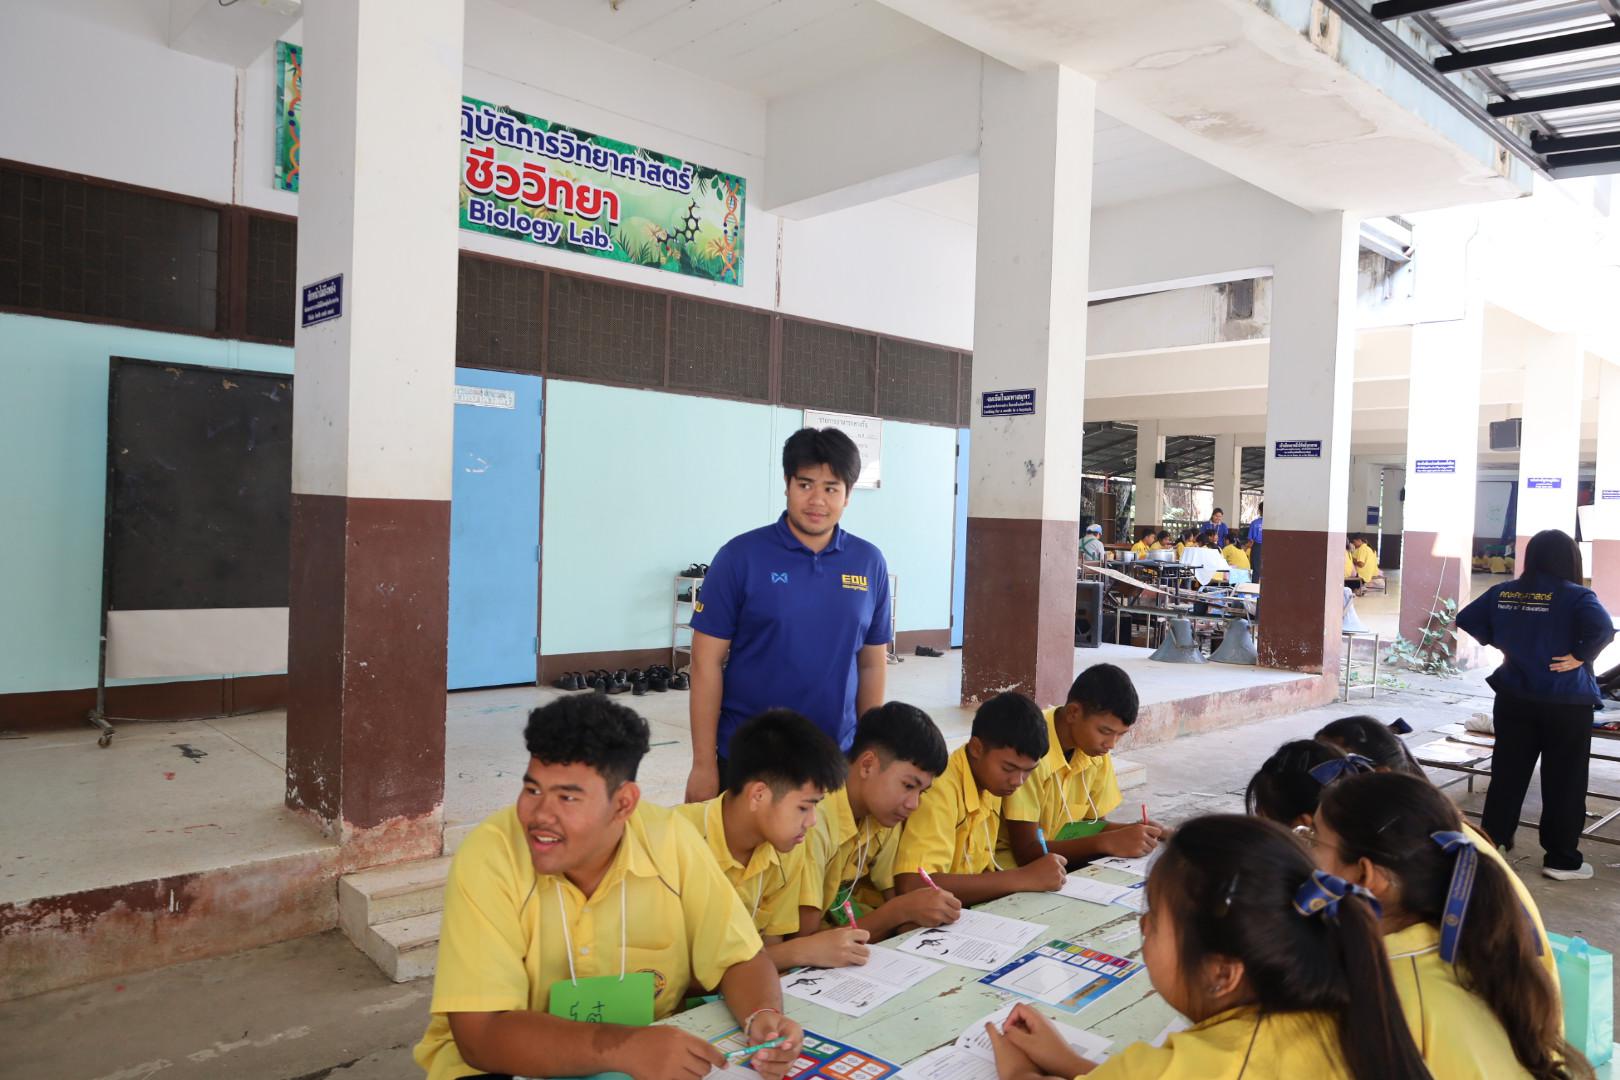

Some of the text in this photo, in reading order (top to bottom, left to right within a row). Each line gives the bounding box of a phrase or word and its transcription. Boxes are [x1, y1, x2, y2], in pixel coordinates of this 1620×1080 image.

[465, 146, 619, 221] ชีววิทยา
[469, 199, 613, 250] Biology Lab.
[842, 574, 867, 586] EDU
